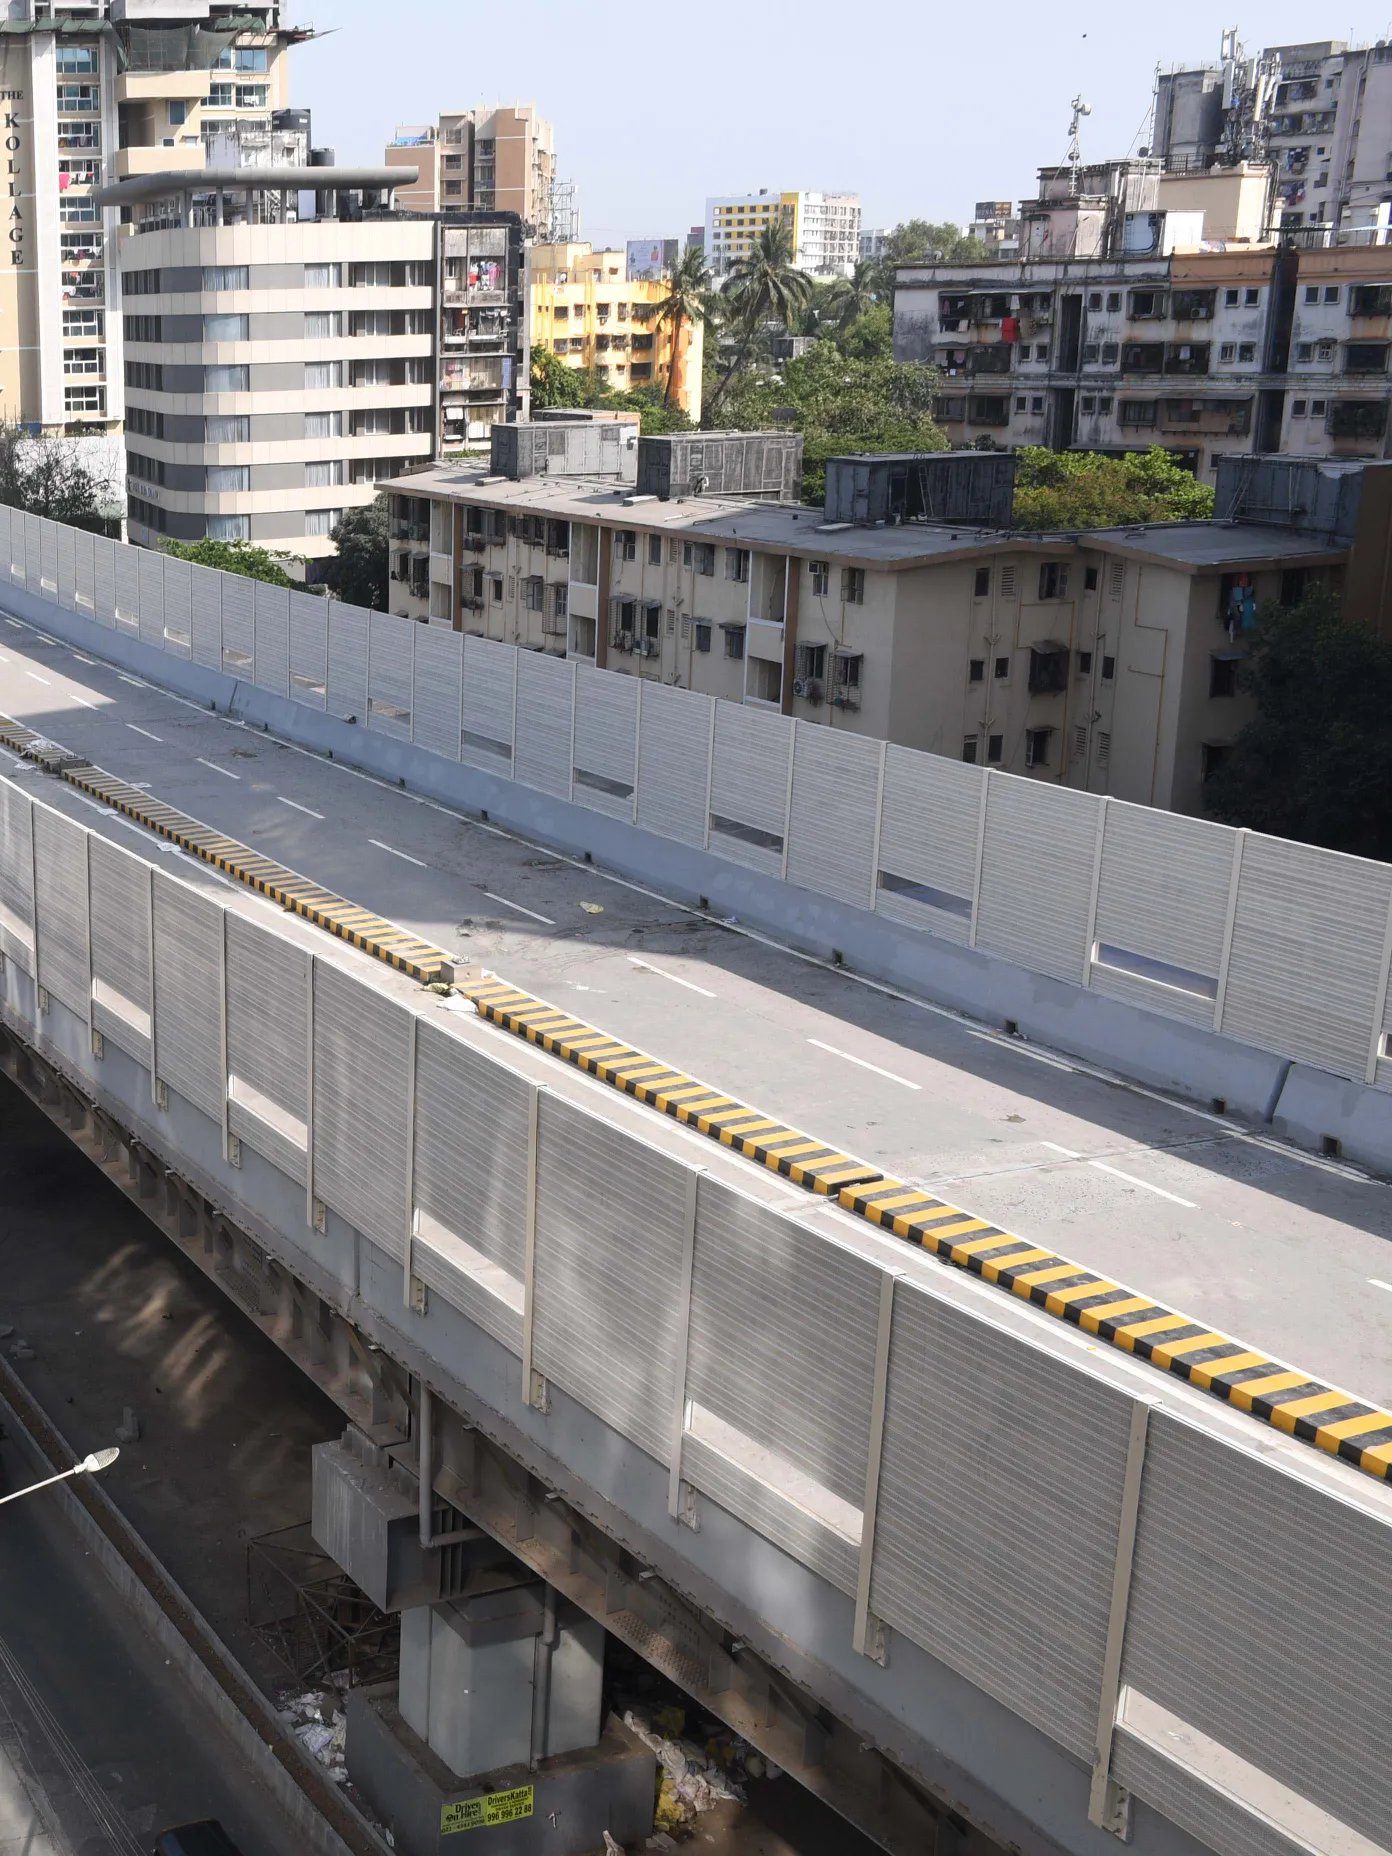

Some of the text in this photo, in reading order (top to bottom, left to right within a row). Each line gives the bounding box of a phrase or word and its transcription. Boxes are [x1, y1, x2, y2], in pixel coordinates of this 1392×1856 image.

[0, 90, 24, 100] THE
[4, 112, 24, 266] KOLLAGE
[455, 1802, 481, 1813] Driver
[461, 1809, 478, 1819] Hire
[488, 1811, 500, 1821] 996
[501, 1809, 513, 1819] 996
[515, 1806, 522, 1816] 22
